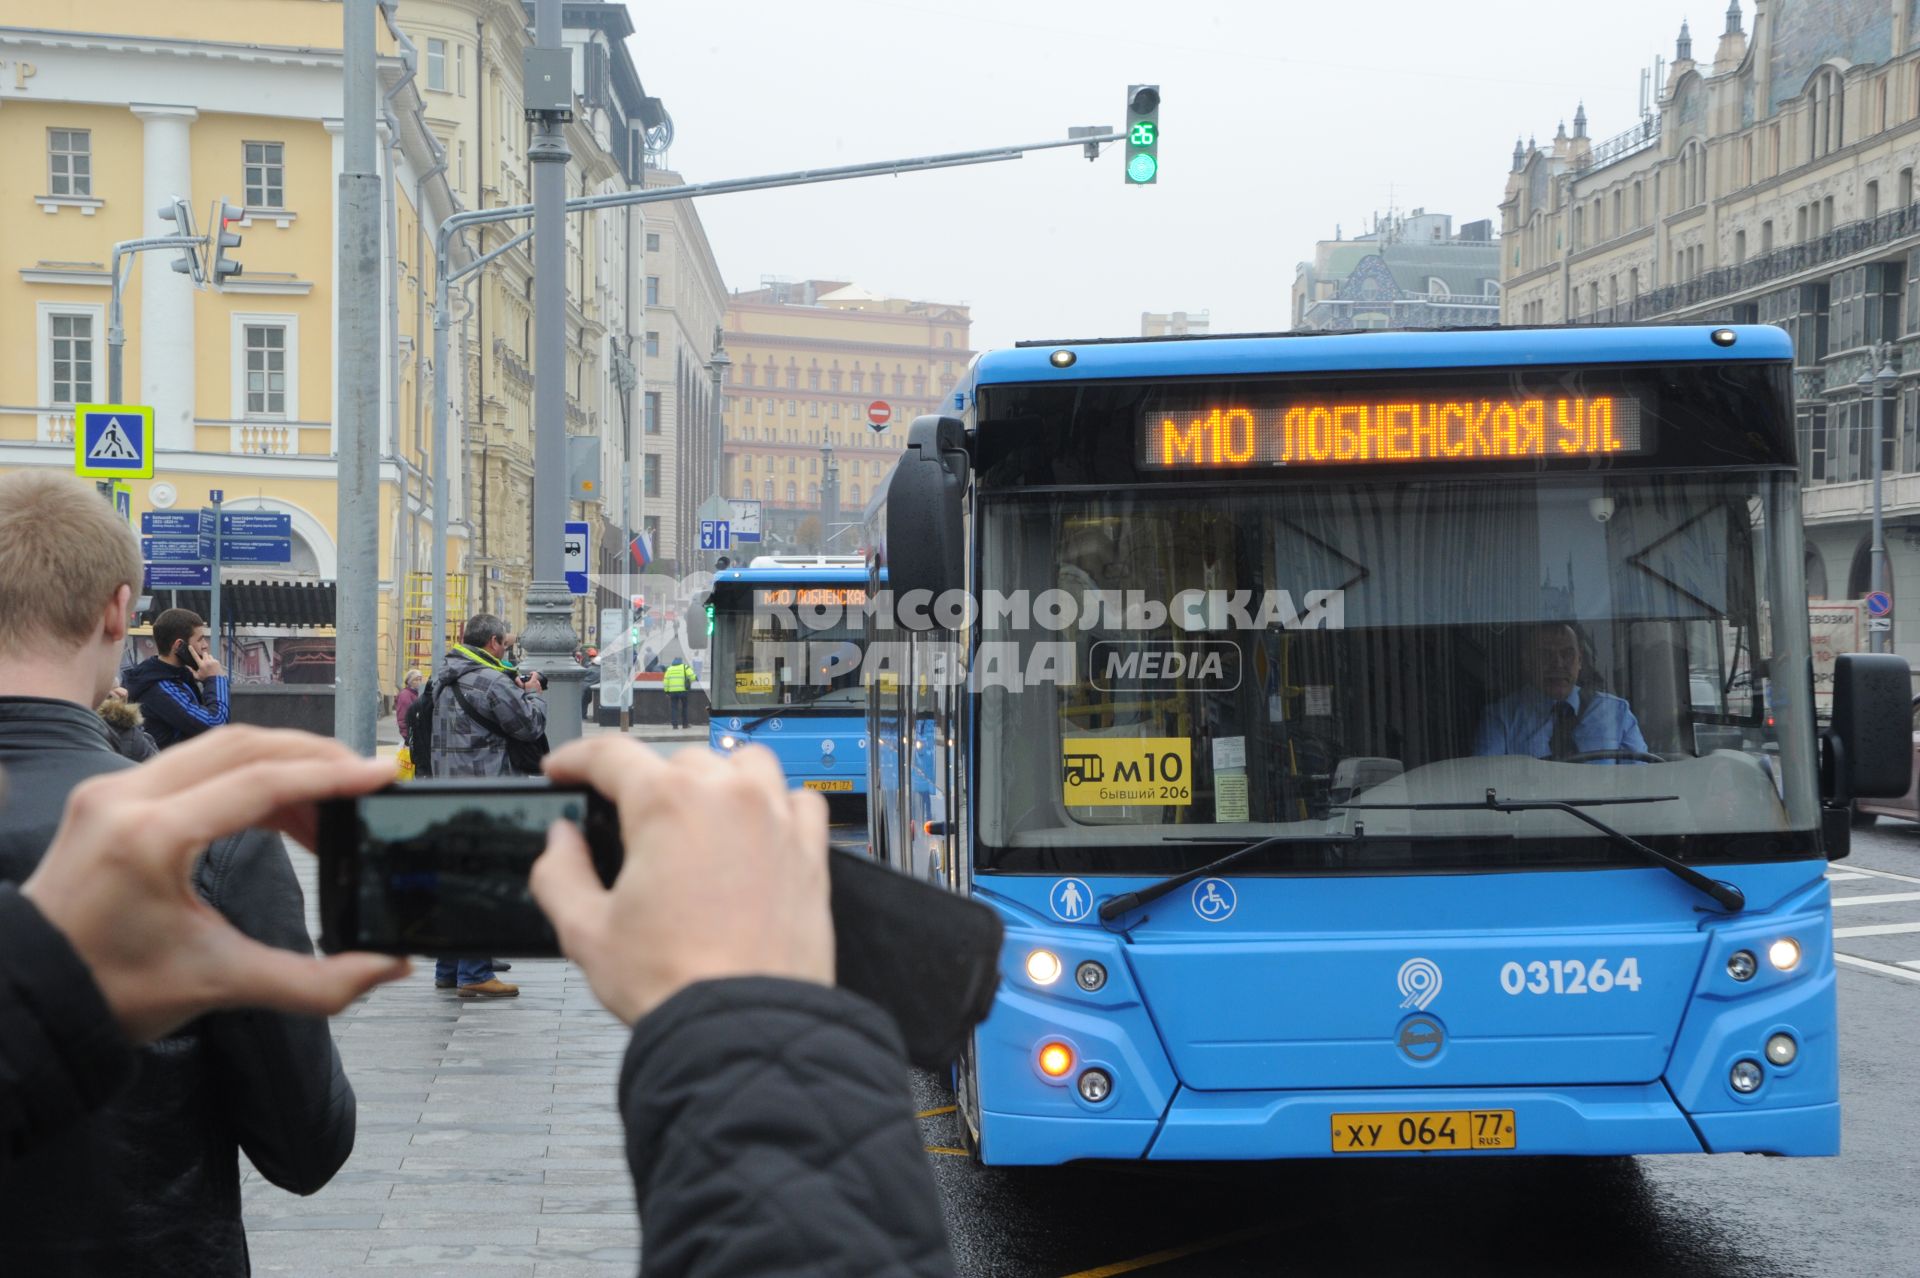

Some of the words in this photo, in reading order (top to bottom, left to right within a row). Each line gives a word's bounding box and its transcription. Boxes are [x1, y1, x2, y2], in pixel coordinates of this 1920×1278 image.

[1131, 124, 1154, 145] 26
[1282, 400, 1544, 461] ЛОБНЕНСКАЯ
[1557, 398, 1621, 453] УЛ.
[821, 782, 837, 790] 071
[1100, 787, 1155, 800] бывший
[1160, 786, 1189, 799] 206
[1500, 957, 1642, 995] 031264
[1400, 1117, 1456, 1145] 064
[1474, 1114, 1504, 1136] 77
[1478, 1137, 1502, 1146] RUS
